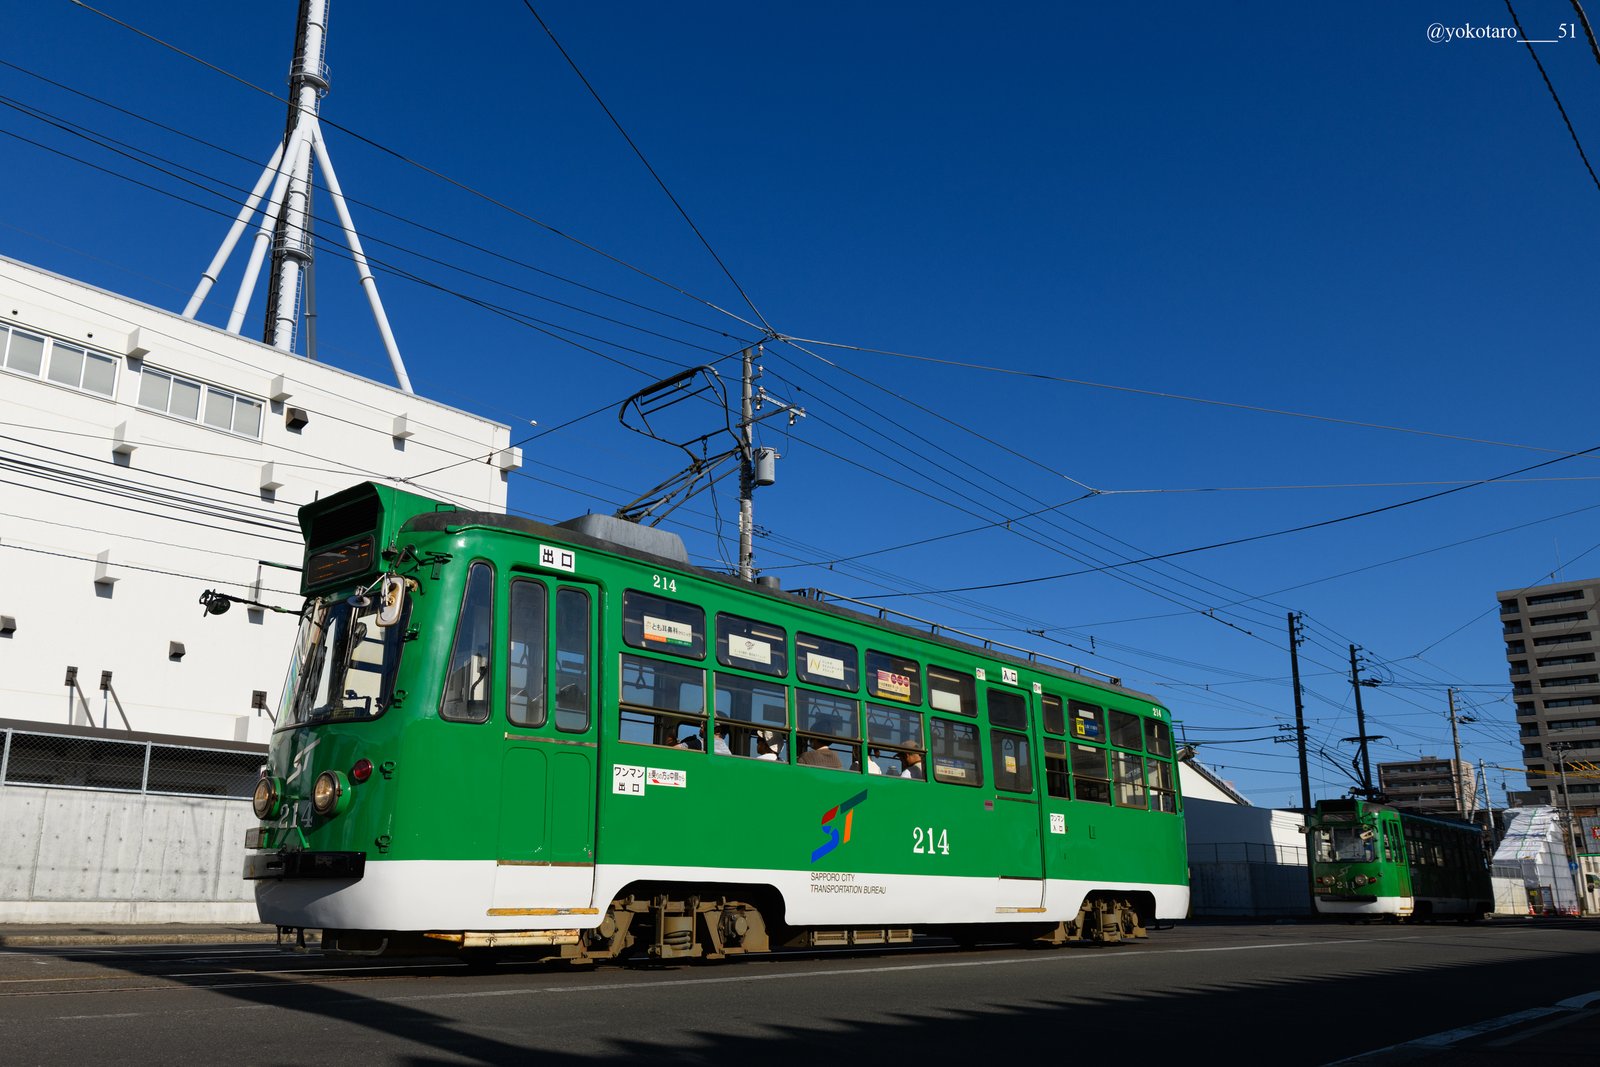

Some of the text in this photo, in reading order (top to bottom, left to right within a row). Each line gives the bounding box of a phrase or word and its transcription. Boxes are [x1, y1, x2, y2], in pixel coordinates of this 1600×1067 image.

[542, 548, 573, 569] 出口
[652, 574, 678, 593] 214
[1003, 670, 1017, 683] 入口
[1152, 707, 1162, 718] 214
[614, 766, 645, 779] ワンマン
[618, 782, 640, 793] 出口
[279, 802, 314, 829] 214
[1050, 814, 1064, 823] ワンマン
[912, 826, 950, 856] 214
[810, 872, 856, 882] SAPPORO CITY
[810, 884, 887, 895] TRANSPORTATION BUREAU
